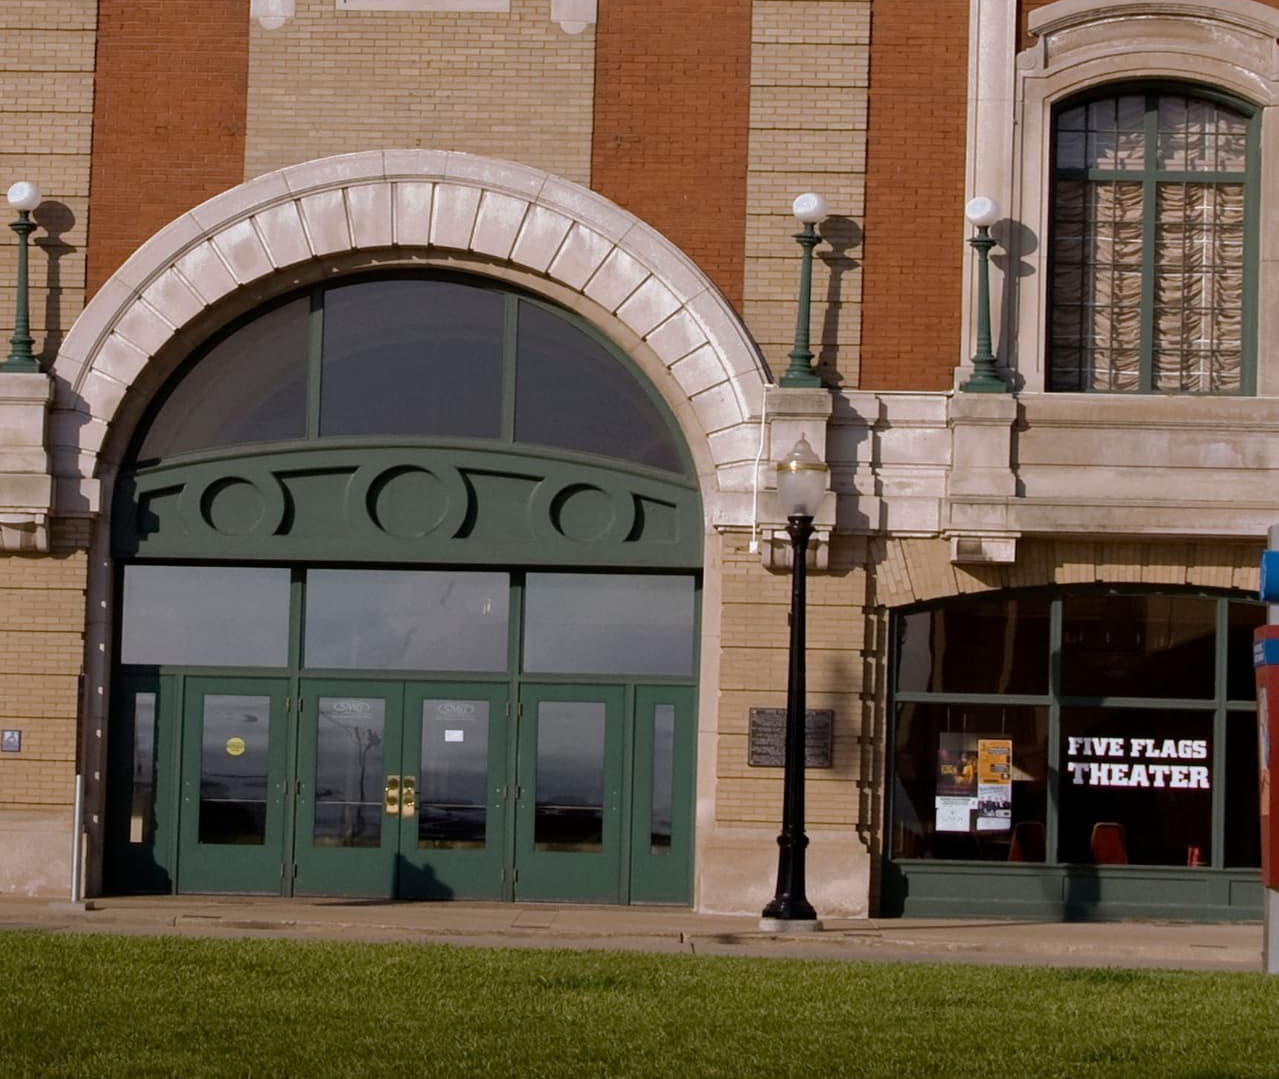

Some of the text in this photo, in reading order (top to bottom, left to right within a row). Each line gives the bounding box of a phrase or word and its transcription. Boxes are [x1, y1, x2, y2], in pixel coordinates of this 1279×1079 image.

[1067, 736, 1207, 759] FIVE FLAGS
[1067, 761, 1210, 789] THEATER
